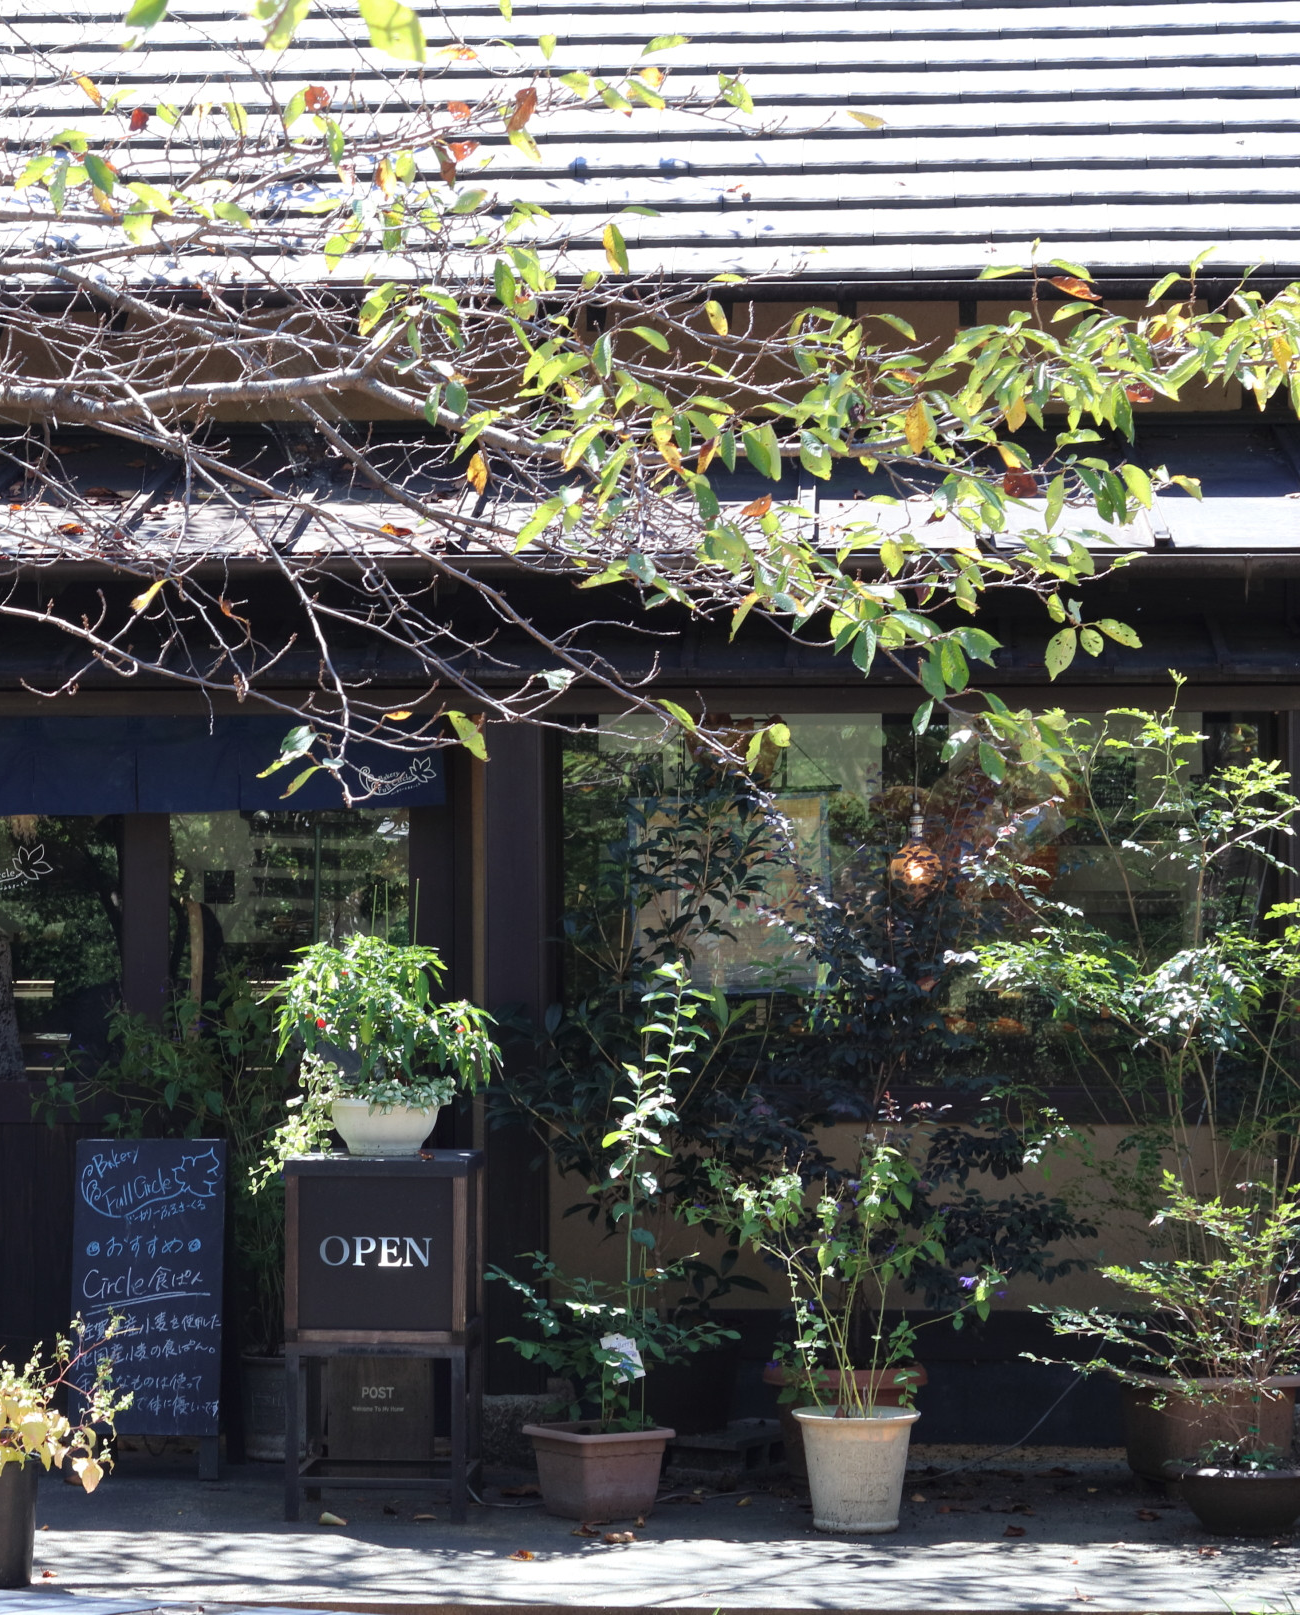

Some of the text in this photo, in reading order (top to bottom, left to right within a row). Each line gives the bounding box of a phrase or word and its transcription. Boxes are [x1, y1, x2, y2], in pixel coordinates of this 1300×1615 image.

[92, 1146, 139, 1178] Bakery
[102, 1167, 172, 1216] Full Circle
[105, 1235, 184, 1258] おすすめ
[319, 1235, 433, 1267] OPEN
[75, 1372, 202, 1394] 余なものは使って
[361, 1386, 395, 1399] POST
